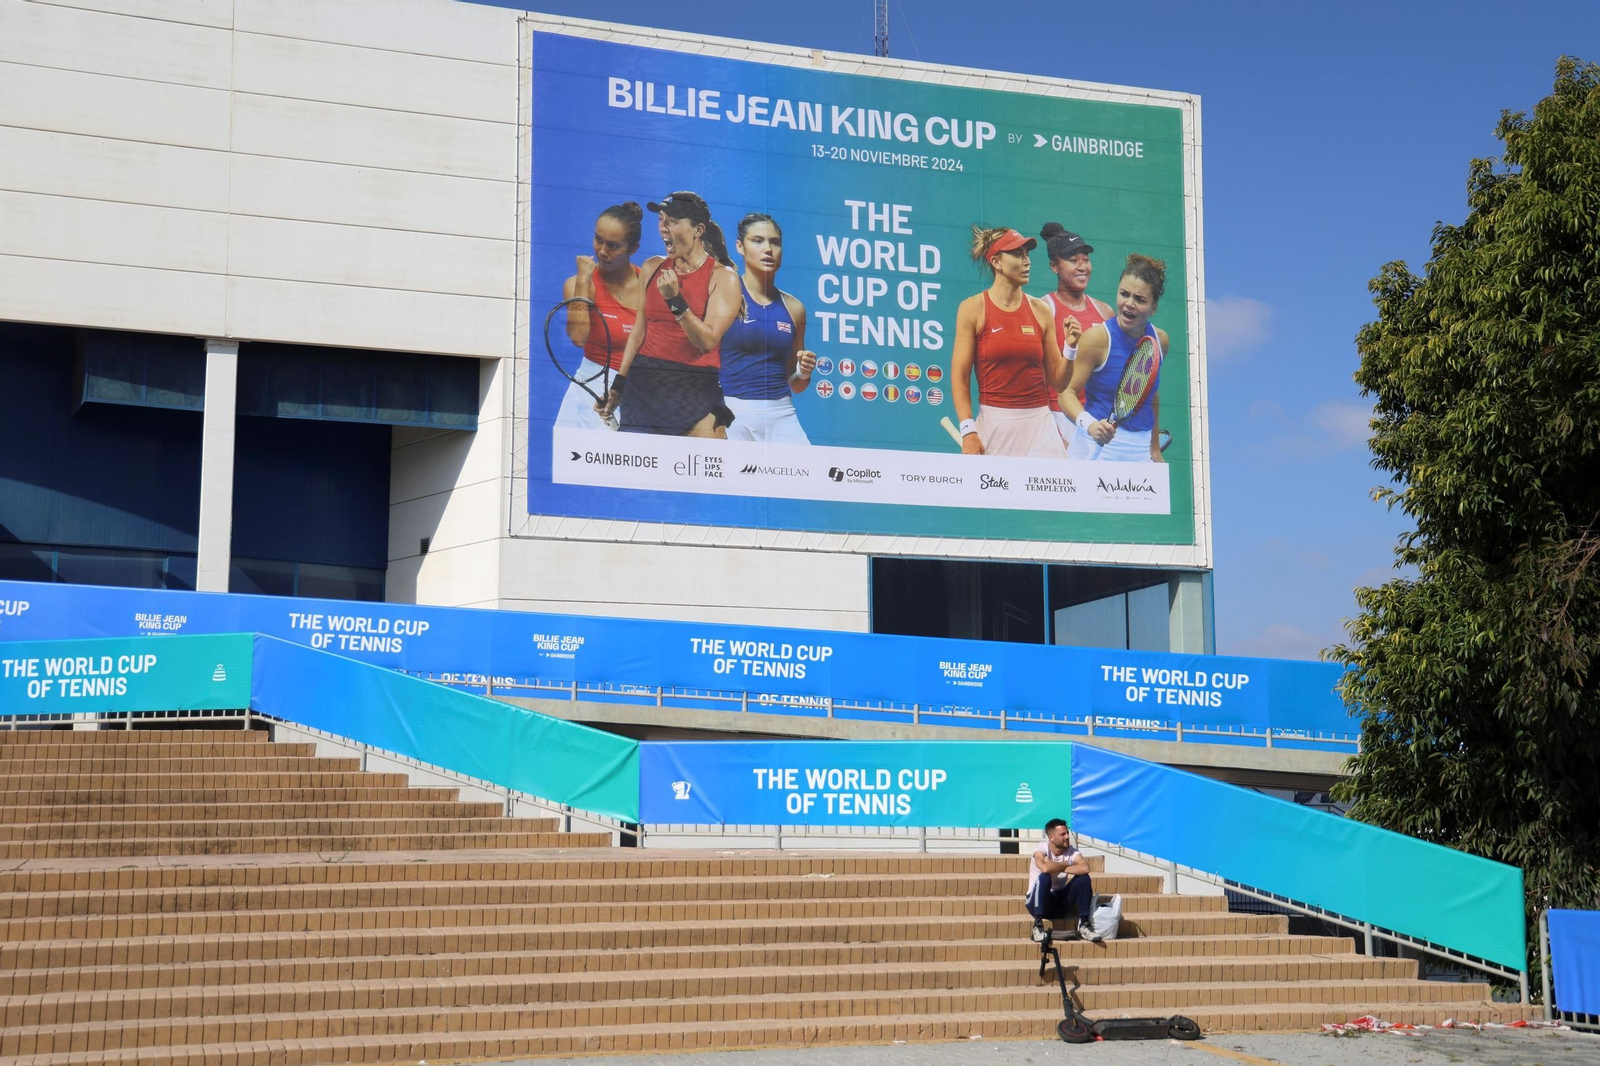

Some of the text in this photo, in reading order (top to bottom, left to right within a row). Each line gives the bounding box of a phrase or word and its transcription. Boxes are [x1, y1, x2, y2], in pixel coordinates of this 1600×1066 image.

[607, 76, 997, 150] BILLIE JEAN KING CUP
[1007, 132, 1144, 159] BY GAINBRIDGE
[811, 144, 964, 172] 13-20 NOVIEMBRE 2024
[844, 199, 913, 235] THE
[815, 234, 941, 275] WORLD
[817, 273, 941, 312] CUP OF
[814, 310, 944, 350] TENNIS
[585, 451, 658, 469] GAINBRIDGE
[704, 456, 725, 464] EYES.
[704, 463, 723, 471] LIPS.
[704, 470, 725, 479] FACE.
[757, 466, 810, 477] MAGELLAN
[845, 468, 882, 479] Copilot
[900, 473, 963, 485] TORY BURCH
[979, 473, 1009, 491] Stake
[1024, 483, 1077, 493] TEMPLETON
[1028, 476, 1073, 486] FRANKLIN
[1095, 476, 1158, 494] Andalucía
[135, 612, 187, 624] BILLIE JEAN
[138, 620, 182, 631] KING CUP
[288, 612, 430, 636] THE WORLD CUP
[310, 632, 403, 654] OF TENNIS
[533, 633, 585, 645] BILLIE JEAN
[537, 641, 580, 652] KING CUP
[690, 637, 833, 662] THE WORLD CUP
[2, 654, 157, 678] THE WORLD CUP
[713, 657, 807, 680] OF TENNIS
[939, 661, 993, 673] BILLIE JEAN
[943, 669, 988, 680] KING CUP
[1100, 665, 1250, 690] THE WORLD CUP
[27, 676, 128, 699] OF TENNIS
[1125, 685, 1223, 708] OF TENNIS
[1106, 716, 1161, 733] TENNIS
[752, 768, 948, 791] THE WORLD CUP
[786, 792, 912, 816] OF TENNIS
